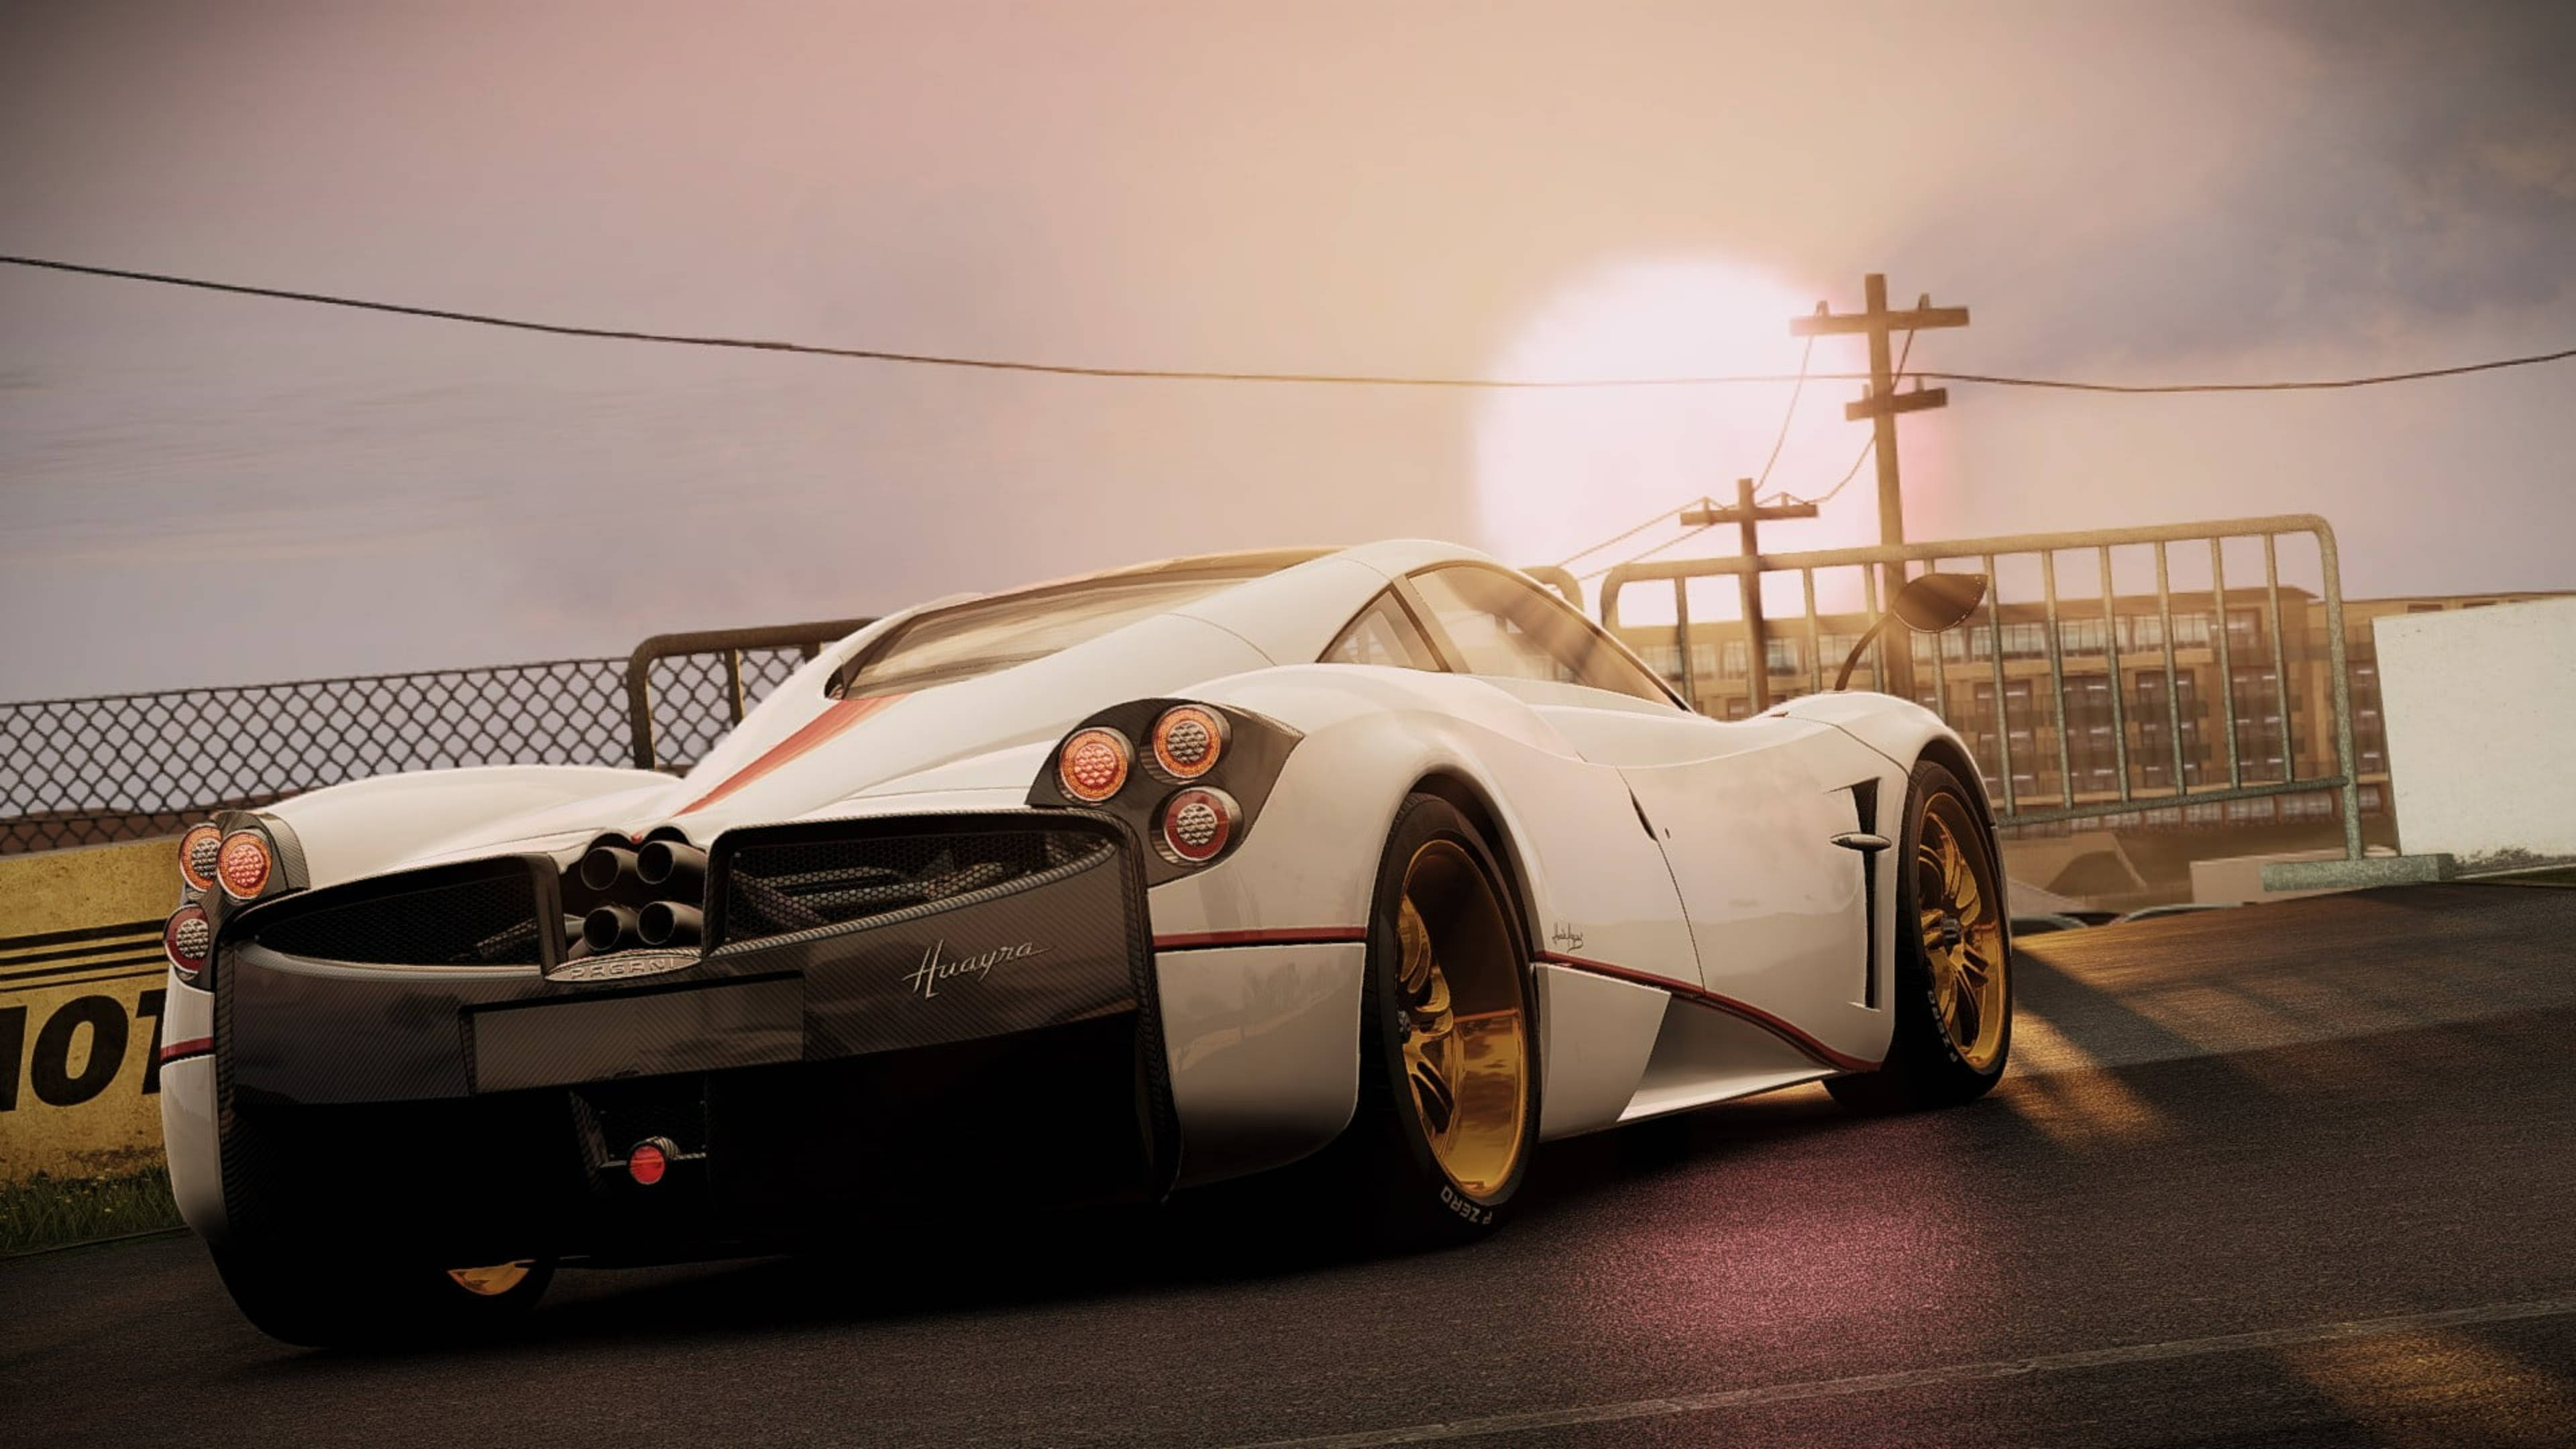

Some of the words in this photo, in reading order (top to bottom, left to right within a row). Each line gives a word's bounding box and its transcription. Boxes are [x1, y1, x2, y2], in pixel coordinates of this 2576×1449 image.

[571, 959, 674, 979] PAGANI
[902, 938, 1057, 998] Huayra
[0, 987, 167, 1112] OT
[1440, 1185, 1481, 1223] ZERO
[1482, 1210, 1493, 1224] P
